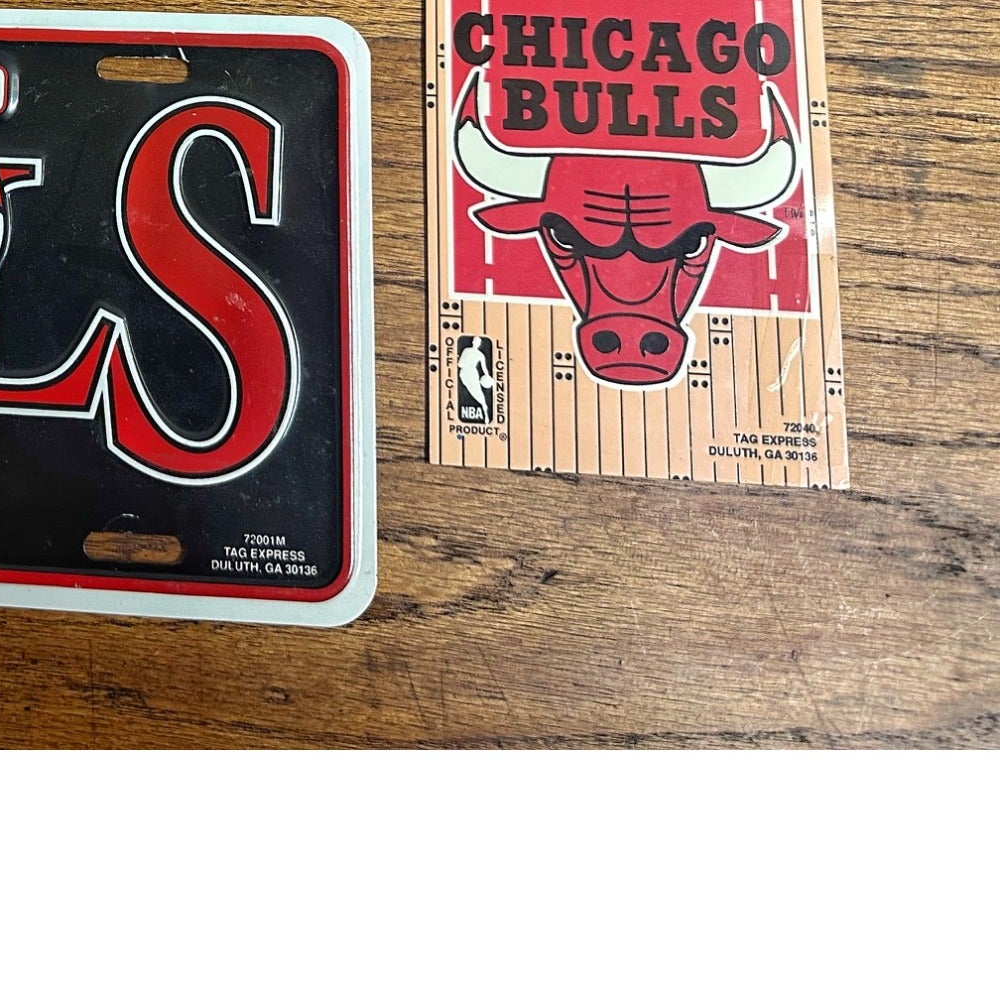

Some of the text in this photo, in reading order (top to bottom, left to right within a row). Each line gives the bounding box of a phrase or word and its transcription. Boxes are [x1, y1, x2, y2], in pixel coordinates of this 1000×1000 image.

[453, 12, 792, 76] CHICAGO
[502, 78, 739, 139] BULLS
[445, 337, 455, 420] OFFICIAL
[495, 339, 506, 424] LICENSED
[461, 406, 484, 420] NBA
[733, 433, 817, 448] TAG EXPRESS
[708, 446, 818, 462] DULUTH, GA 30136
[243, 534, 286, 546] 72001M
[223, 546, 306, 562] TAG EXPRESS
[211, 559, 318, 576] DULUTH, GA 30136
